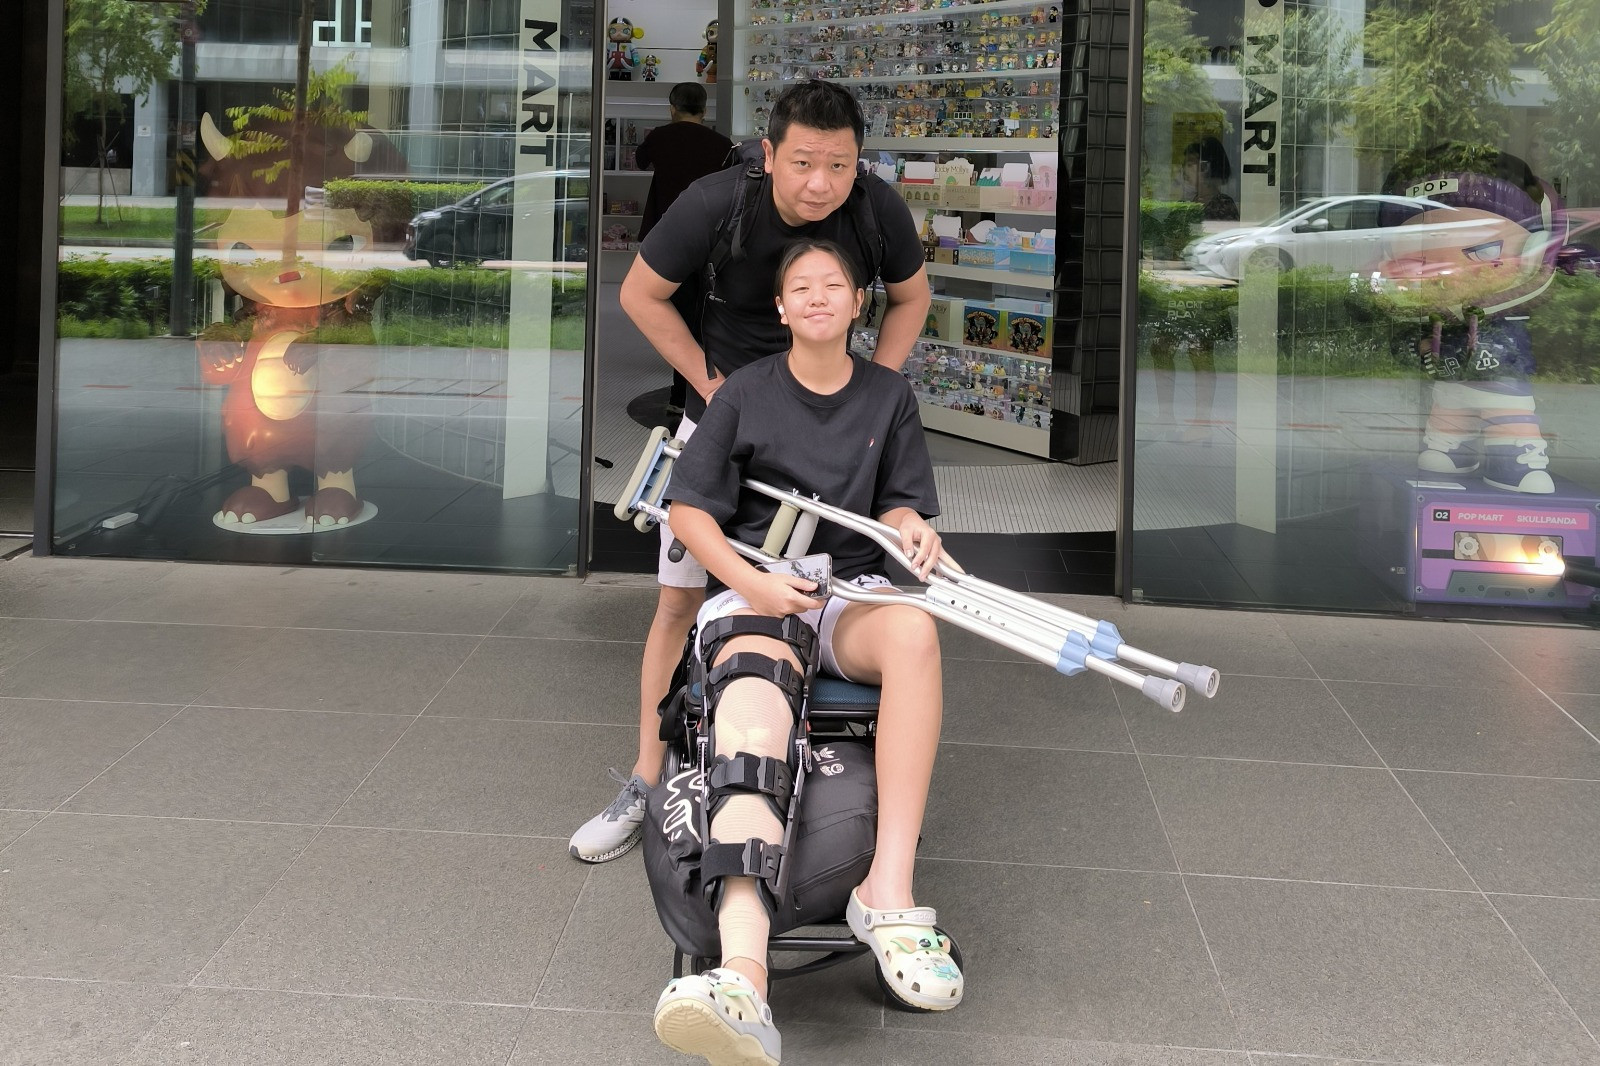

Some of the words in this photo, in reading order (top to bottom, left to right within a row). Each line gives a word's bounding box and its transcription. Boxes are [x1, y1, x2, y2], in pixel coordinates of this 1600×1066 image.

[520, 19, 557, 166] MART
[1243, 34, 1279, 186] MART
[1412, 181, 1448, 196] POP
[1435, 511, 1449, 519] 02
[1457, 512, 1477, 521] POP
[1477, 513, 1504, 522] MART
[1516, 514, 1577, 525] SKULLPANDA
